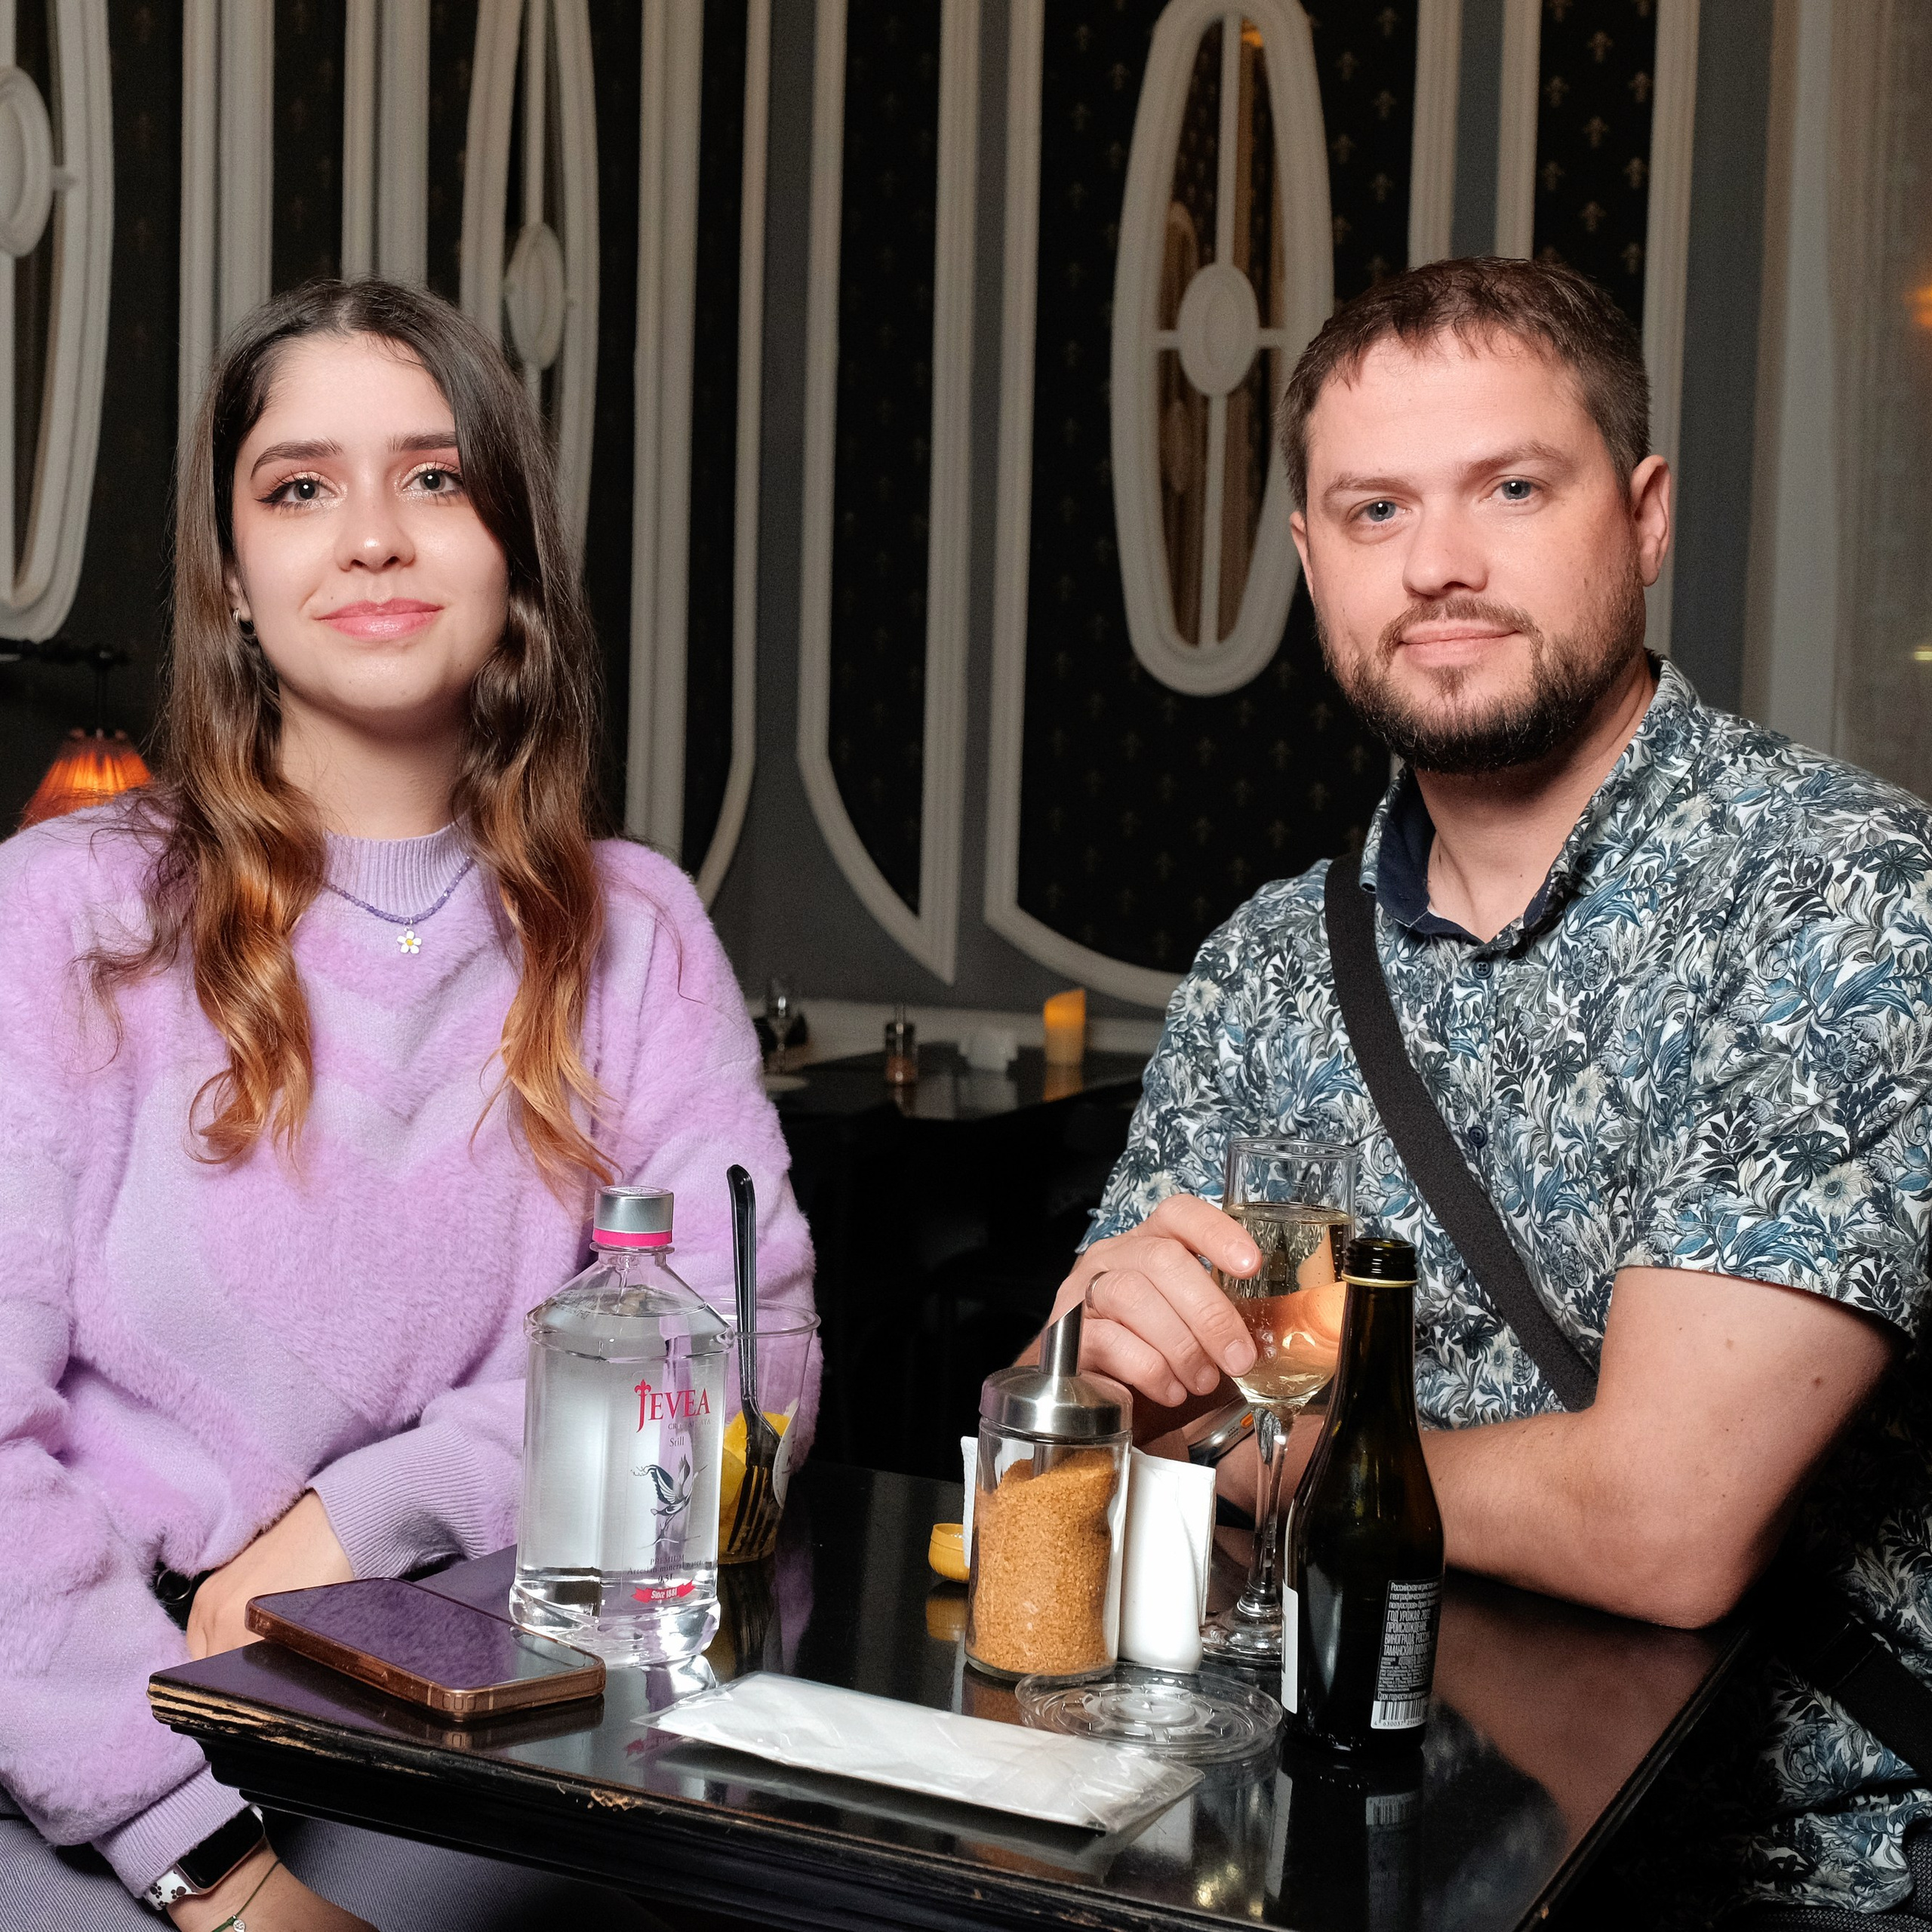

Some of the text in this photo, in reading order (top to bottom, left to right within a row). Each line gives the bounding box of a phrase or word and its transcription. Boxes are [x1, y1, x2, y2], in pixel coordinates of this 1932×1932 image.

[635, 1380, 710, 1433] JEVEA
[669, 1436, 685, 1447] Still
[650, 1555, 685, 1566] PREMIUM
[627, 1567, 657, 1576] Artesian
[660, 1561, 684, 1573] mineral
[651, 1588, 678, 1599] Since 1881
[1387, 1611, 1398, 1622] ГОД
[1386, 1621, 1426, 1633] ПРОИСХОЖДЕНИЕ
[1384, 1644, 1414, 1656] ТАМАНСКИЙ
[1377, 1691, 1388, 1701] Срок
